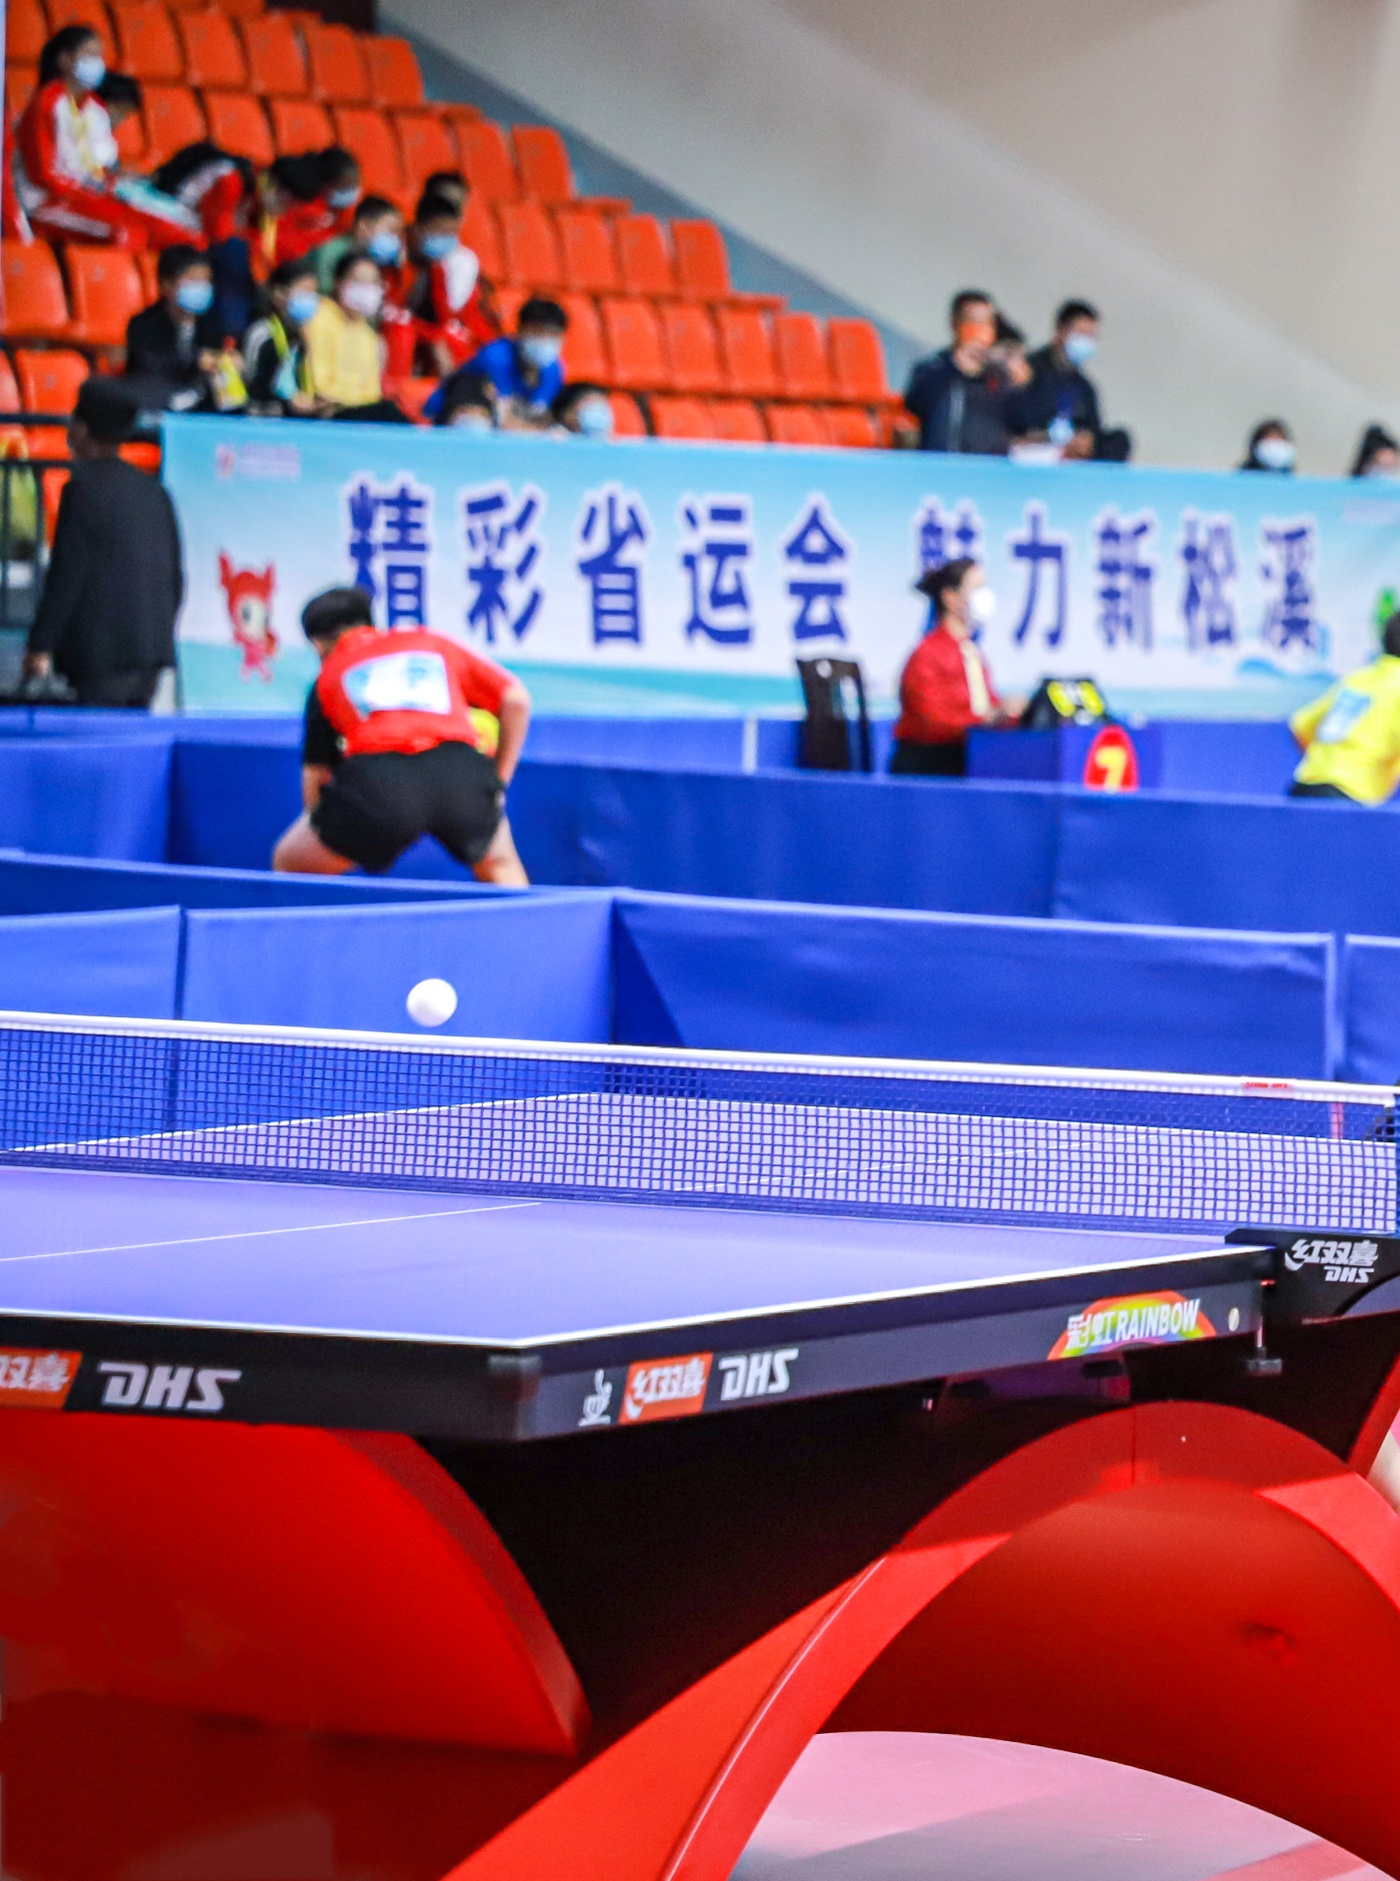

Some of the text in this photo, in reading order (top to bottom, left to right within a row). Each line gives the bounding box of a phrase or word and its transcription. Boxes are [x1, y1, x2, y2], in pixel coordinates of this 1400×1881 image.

[347, 480, 848, 645] 精彩省运会
[1284, 1238, 1379, 1271] 红双喜
[1323, 1265, 1375, 1284] DHS
[1115, 1298, 1201, 1342] RAINBOW
[98, 1360, 243, 1413] DHS
[625, 1356, 707, 1420] 红双喜
[718, 1347, 799, 1402] DHS
